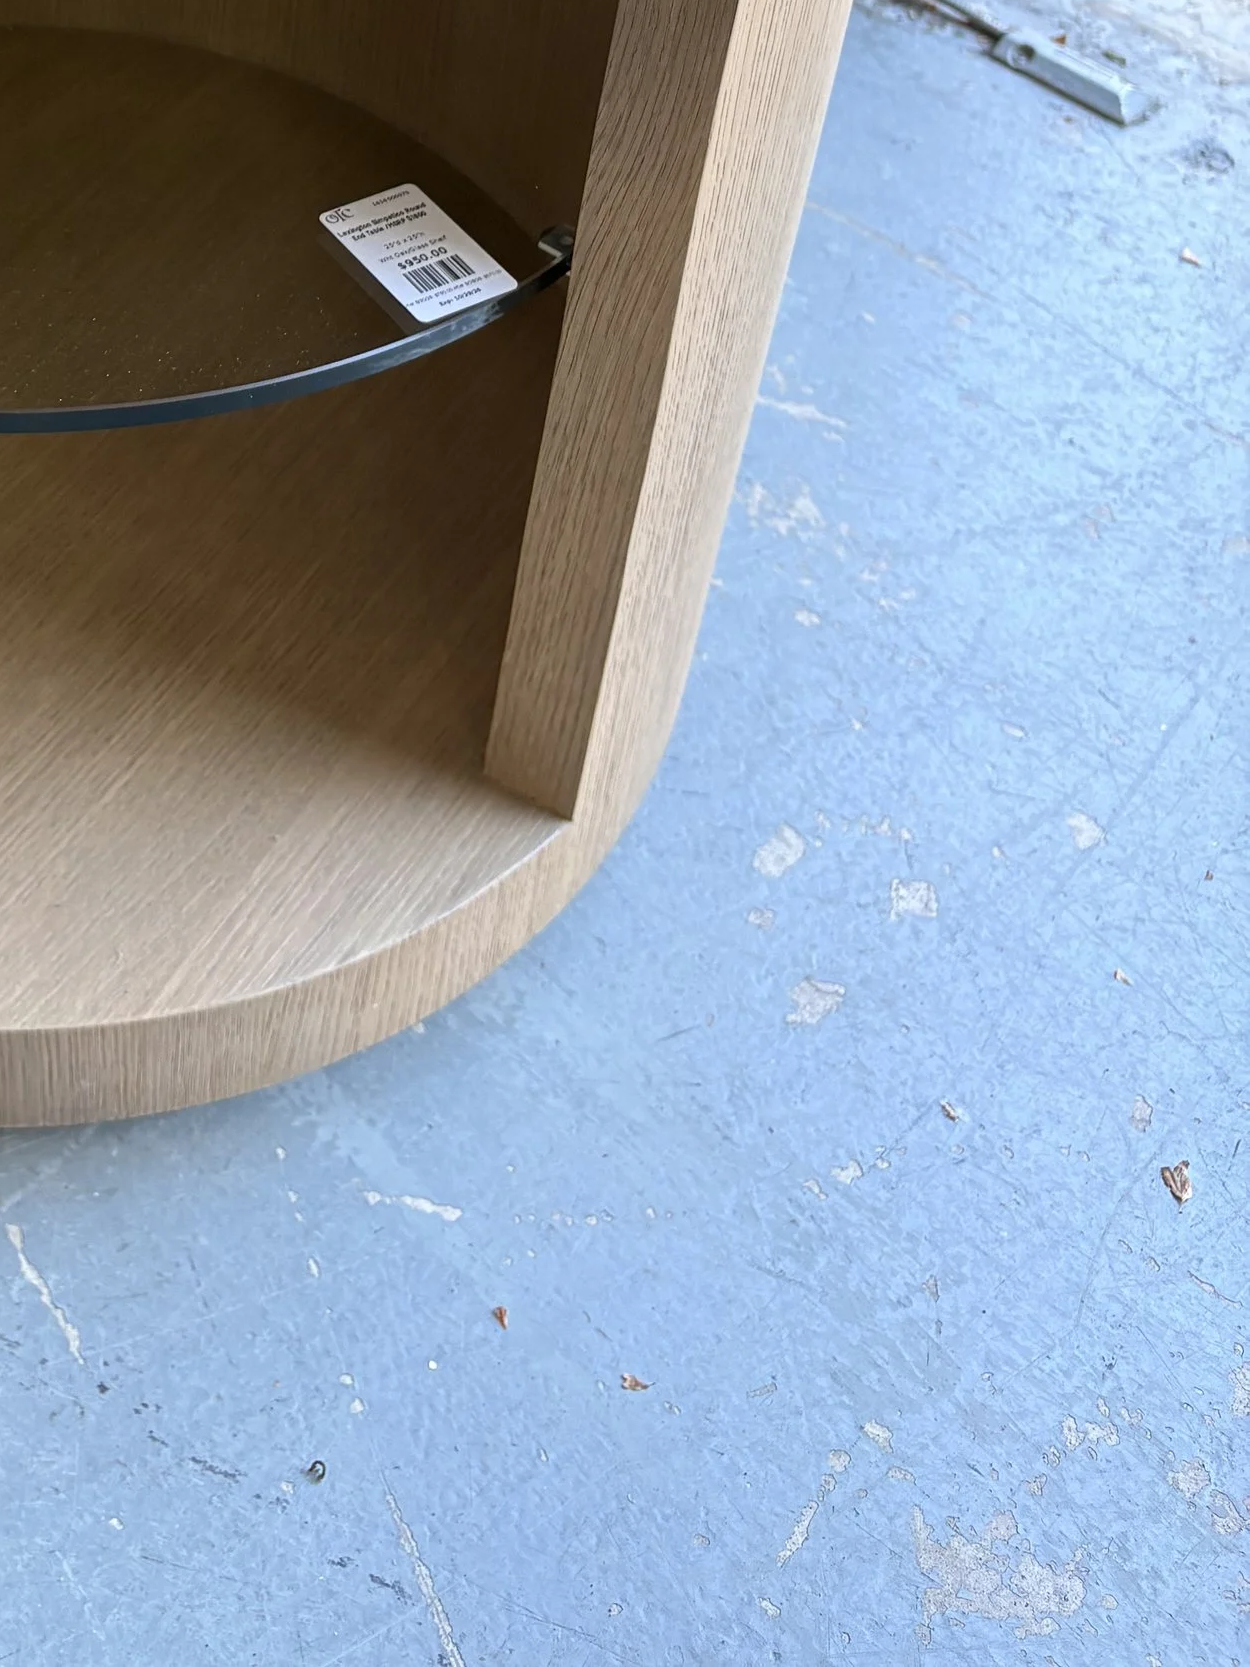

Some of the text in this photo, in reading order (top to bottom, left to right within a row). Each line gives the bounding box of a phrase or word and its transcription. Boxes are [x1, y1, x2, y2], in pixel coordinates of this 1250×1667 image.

[352, 232, 366, 242] End
[366, 225, 385, 236] Table
[397, 246, 448, 270] $950.00
